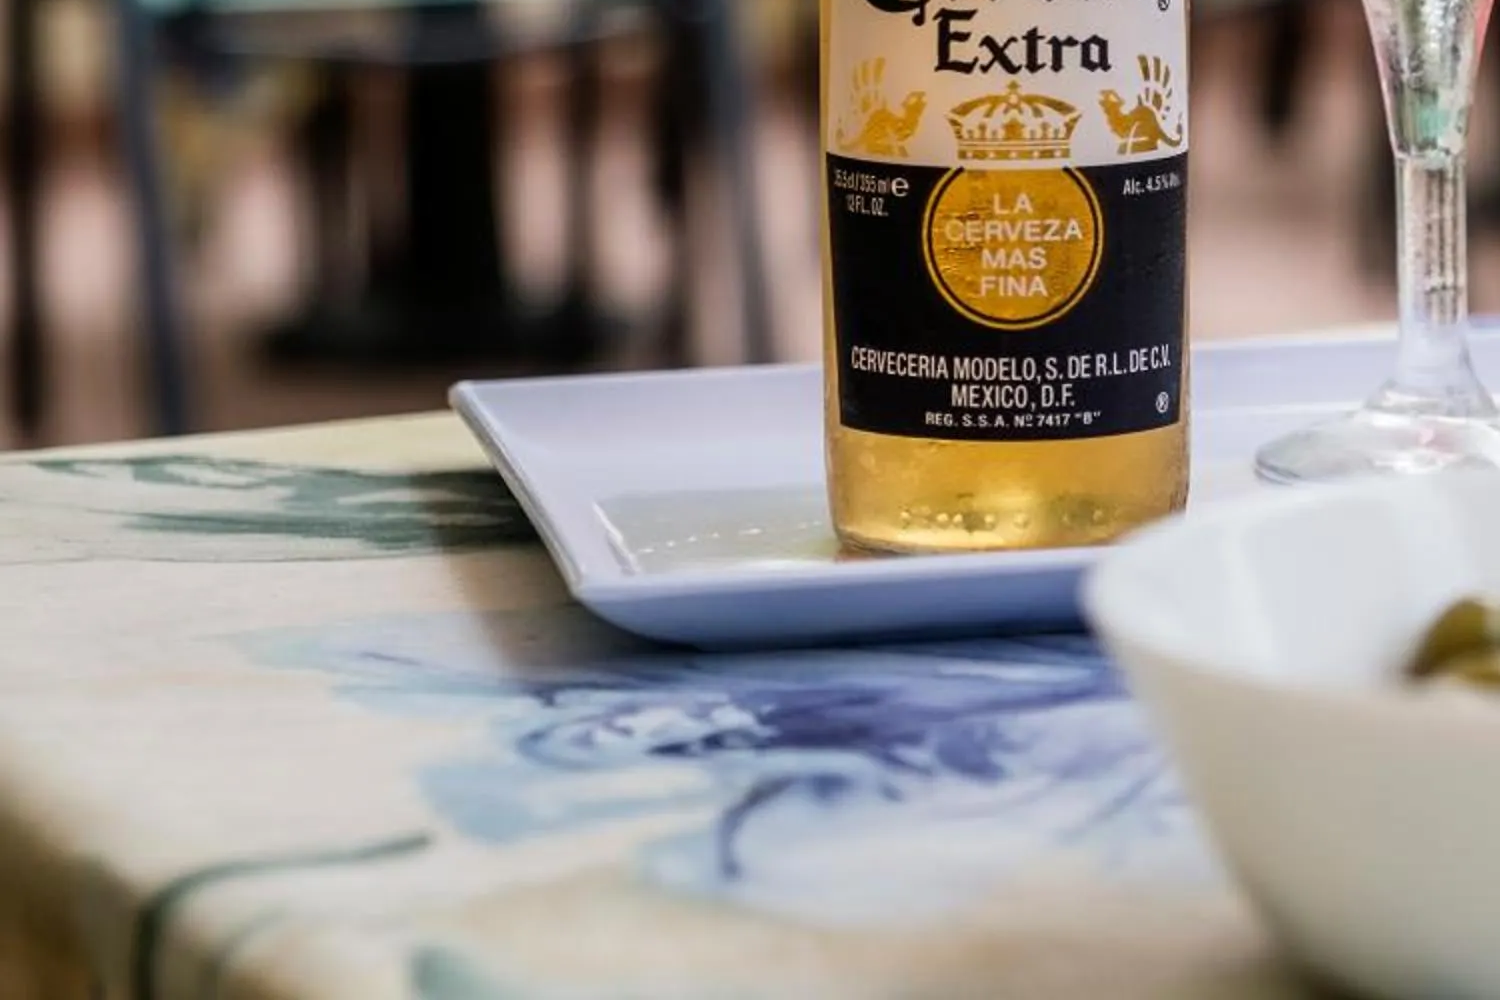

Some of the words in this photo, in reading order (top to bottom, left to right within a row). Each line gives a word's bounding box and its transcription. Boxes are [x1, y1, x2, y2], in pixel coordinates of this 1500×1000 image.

[932, 7, 1111, 75] Extra
[993, 193, 1032, 214] LA
[945, 219, 1083, 243] CERVEZA
[981, 247, 1046, 270] MAS
[980, 275, 1048, 297] FINA
[851, 345, 949, 379] CERVECERIA
[953, 356, 1041, 384] MODELO,
[1045, 357, 1063, 380] S.
[1067, 354, 1091, 379] DE
[1095, 352, 1127, 377] R.L.
[1129, 348, 1148, 373] DE
[1150, 344, 1171, 369] C.V.
[951, 383, 1036, 411] MEXICO,
[1041, 383, 1075, 407] D.F.
[924, 411, 958, 427] REG.
[1036, 412, 1071, 427] 7417
